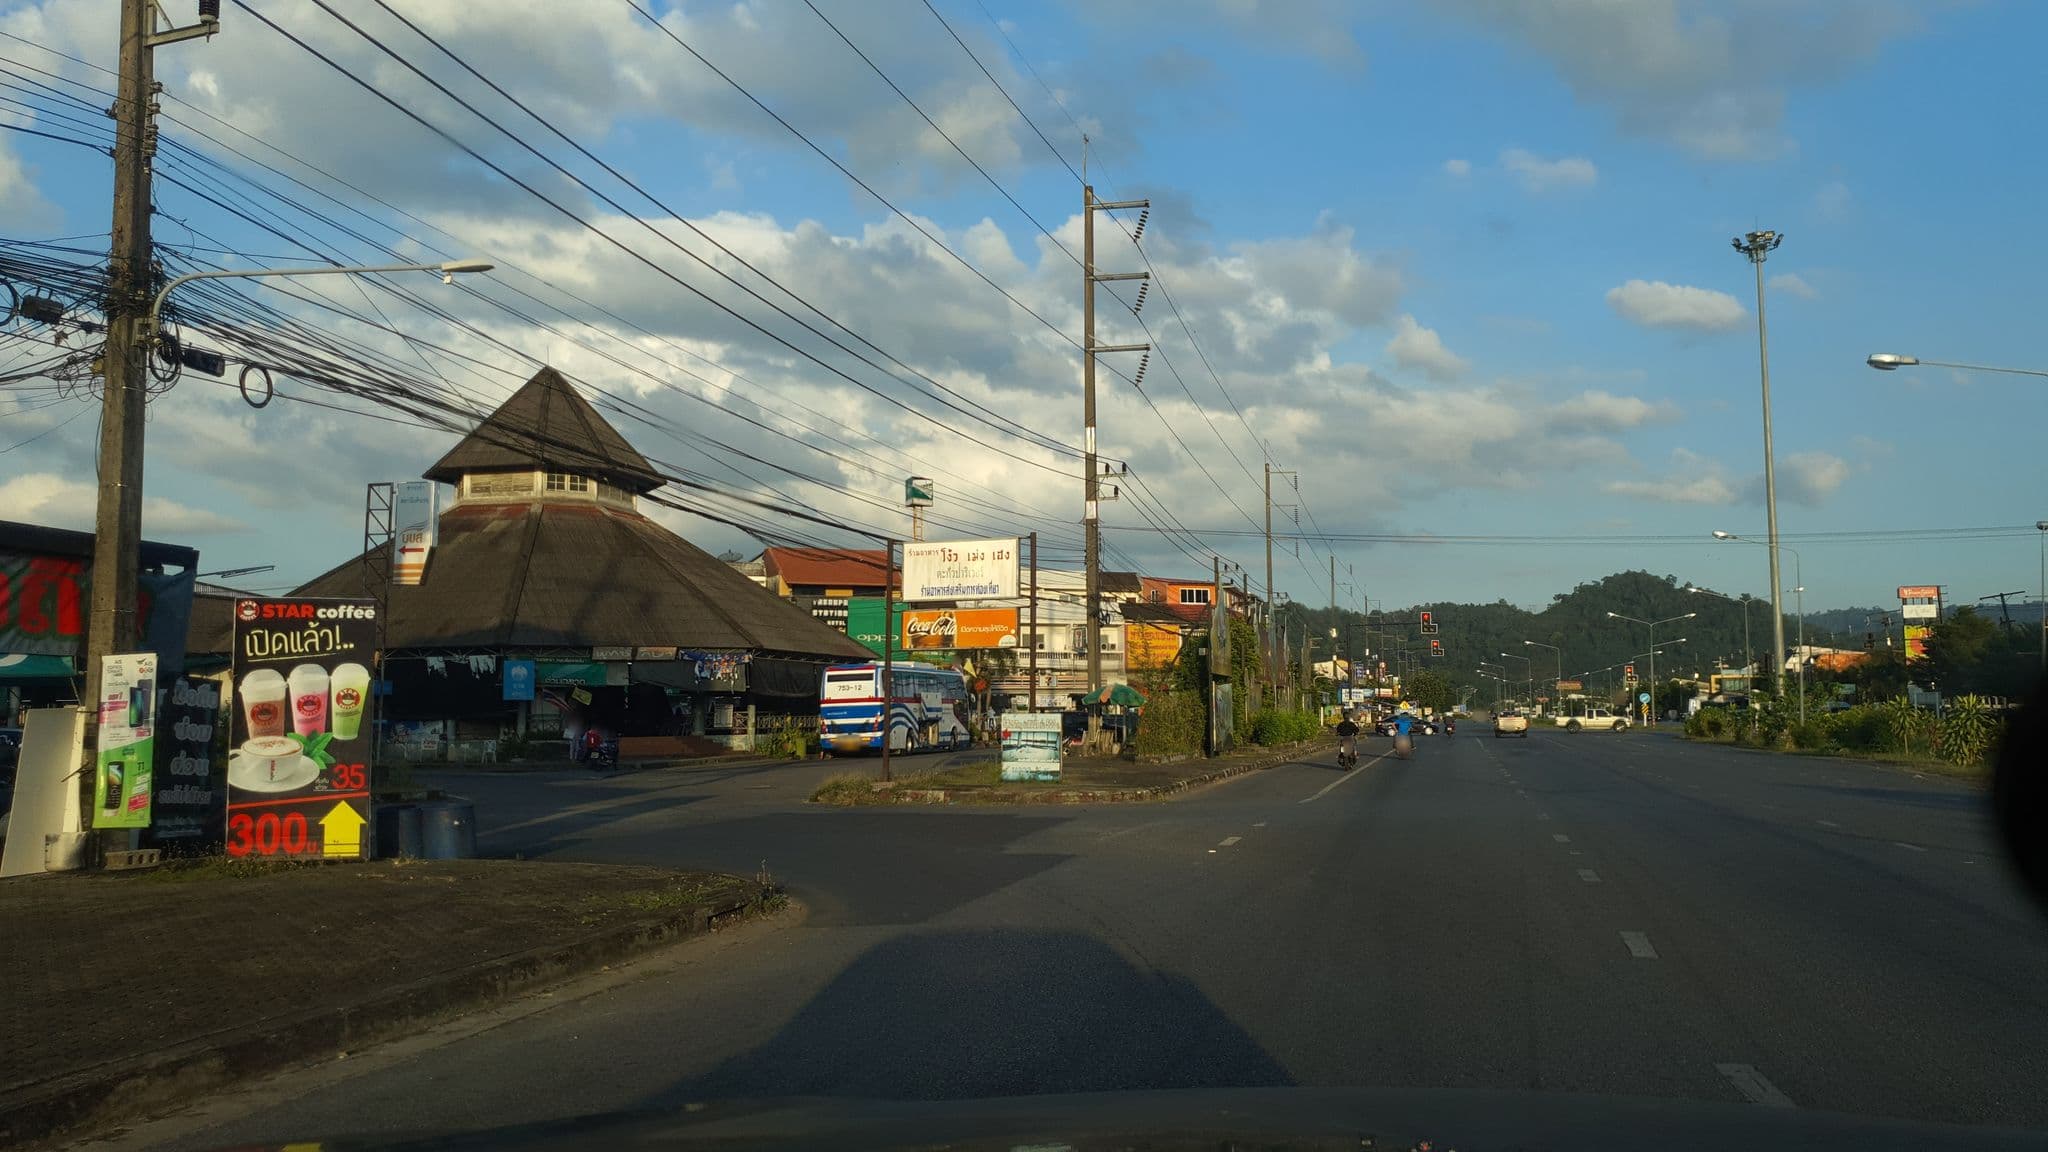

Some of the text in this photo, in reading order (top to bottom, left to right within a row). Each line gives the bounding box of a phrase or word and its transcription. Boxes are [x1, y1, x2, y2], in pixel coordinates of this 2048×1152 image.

[263, 603, 376, 619] STAR coffee
[332, 763, 366, 790] 35
